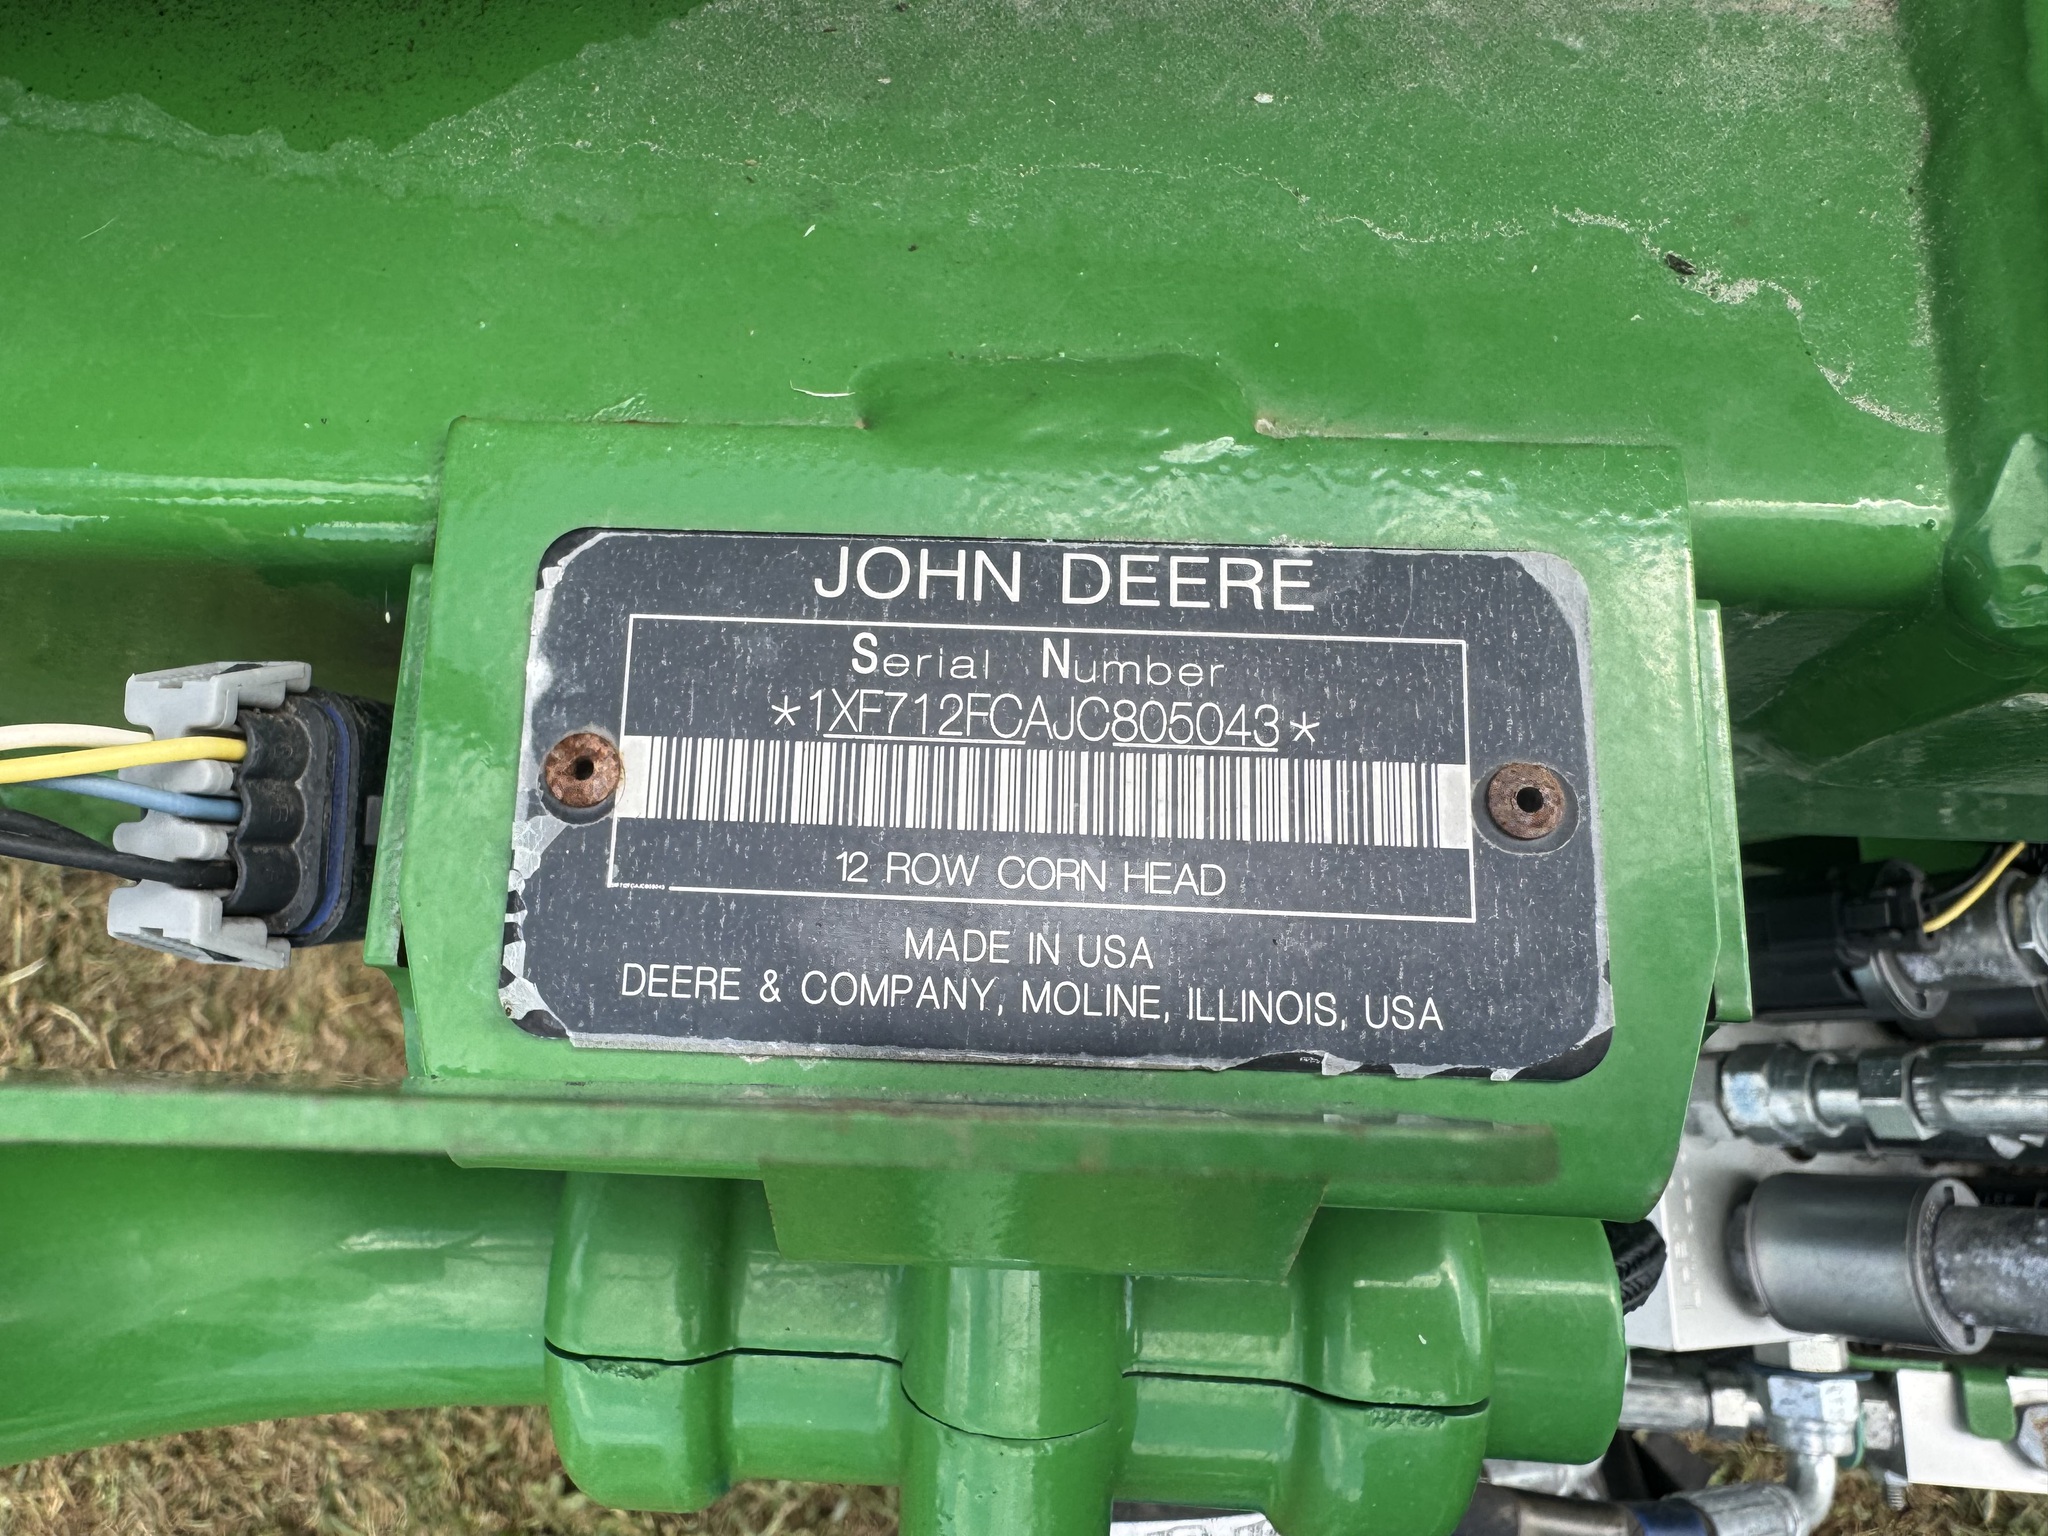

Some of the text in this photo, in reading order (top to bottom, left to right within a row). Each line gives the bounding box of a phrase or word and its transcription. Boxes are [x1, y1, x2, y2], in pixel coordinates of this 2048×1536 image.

[814, 546, 1314, 611] JOHN DEERE
[852, 632, 1226, 687] Serial Number
[836, 851, 1226, 896] 12 ROW CORN HEAD
[904, 928, 1154, 969] MADE IN USA
[622, 963, 1444, 1030] DEERE & COMPANY, MOLINE, ILLINOIS, USA
